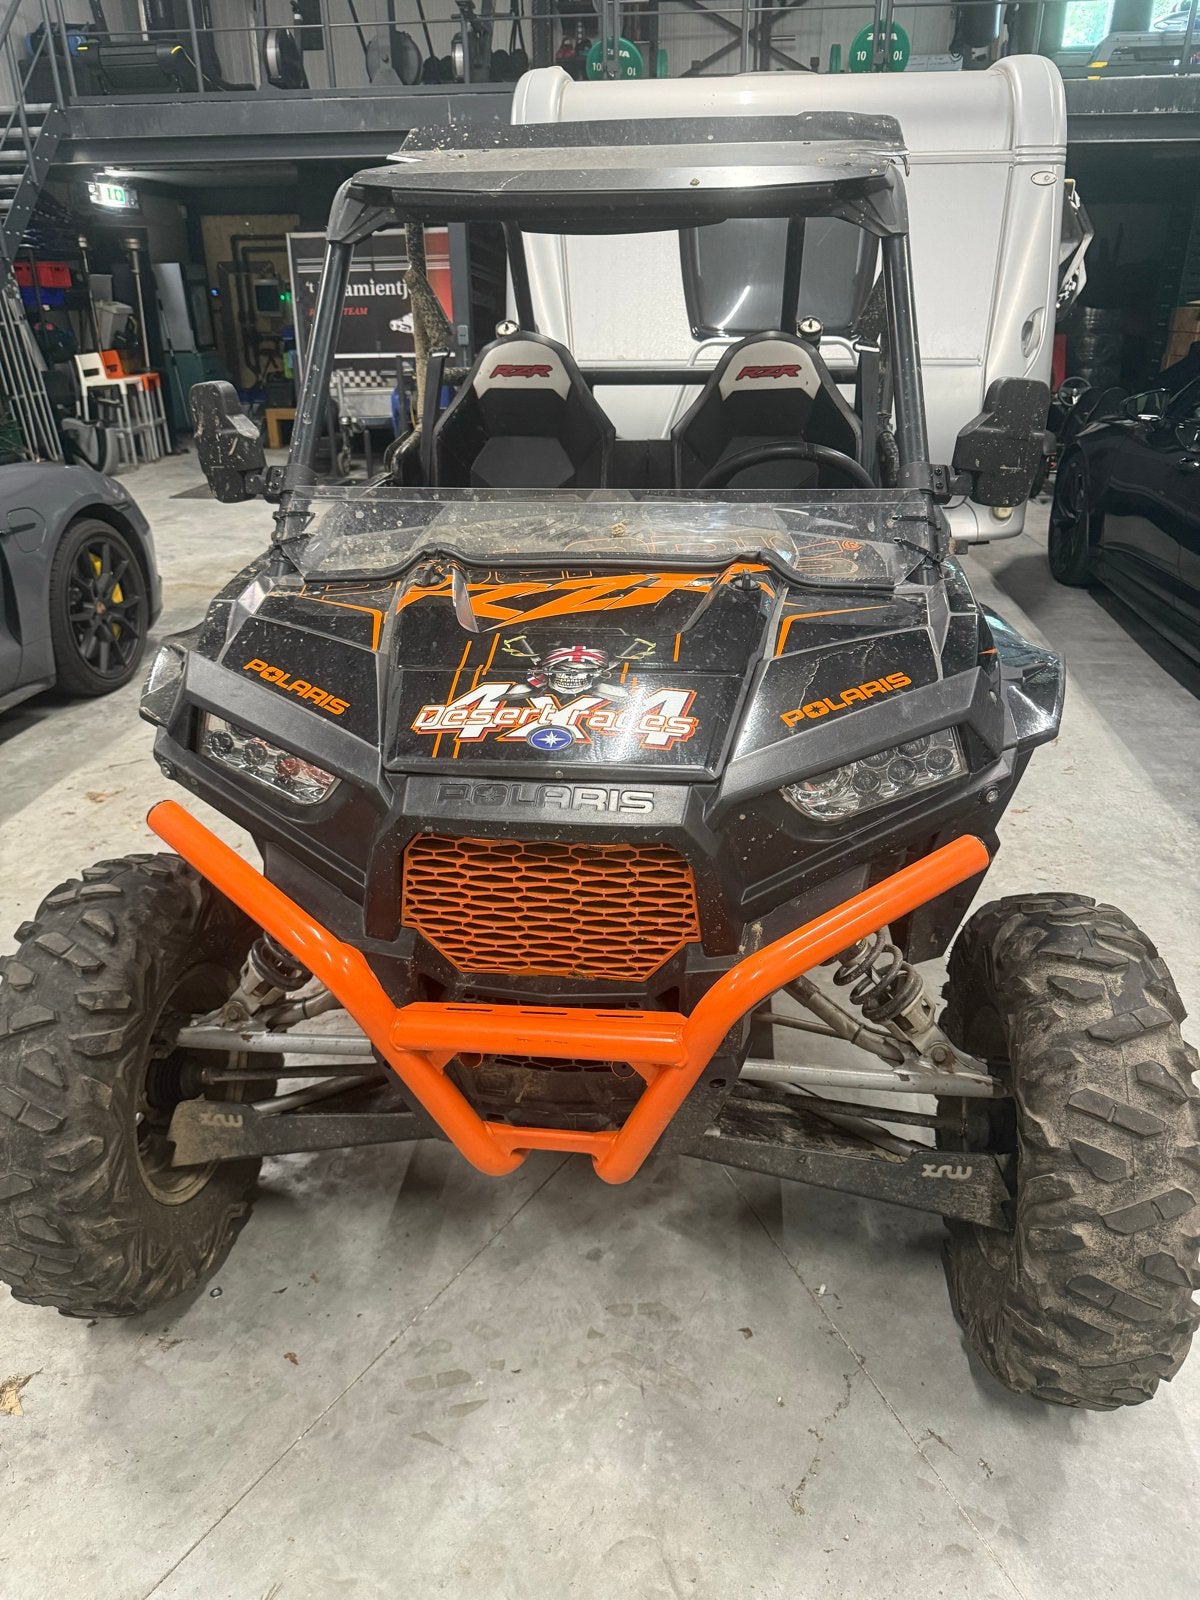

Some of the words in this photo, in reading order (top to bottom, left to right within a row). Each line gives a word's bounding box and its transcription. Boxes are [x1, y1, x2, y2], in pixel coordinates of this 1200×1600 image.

[856, 50, 867, 61] 10
[343, 307, 369, 316] TEAM
[242, 658, 351, 716] POLARIS
[780, 671, 912, 728] POLARIS
[433, 783, 656, 814] POLARIS
